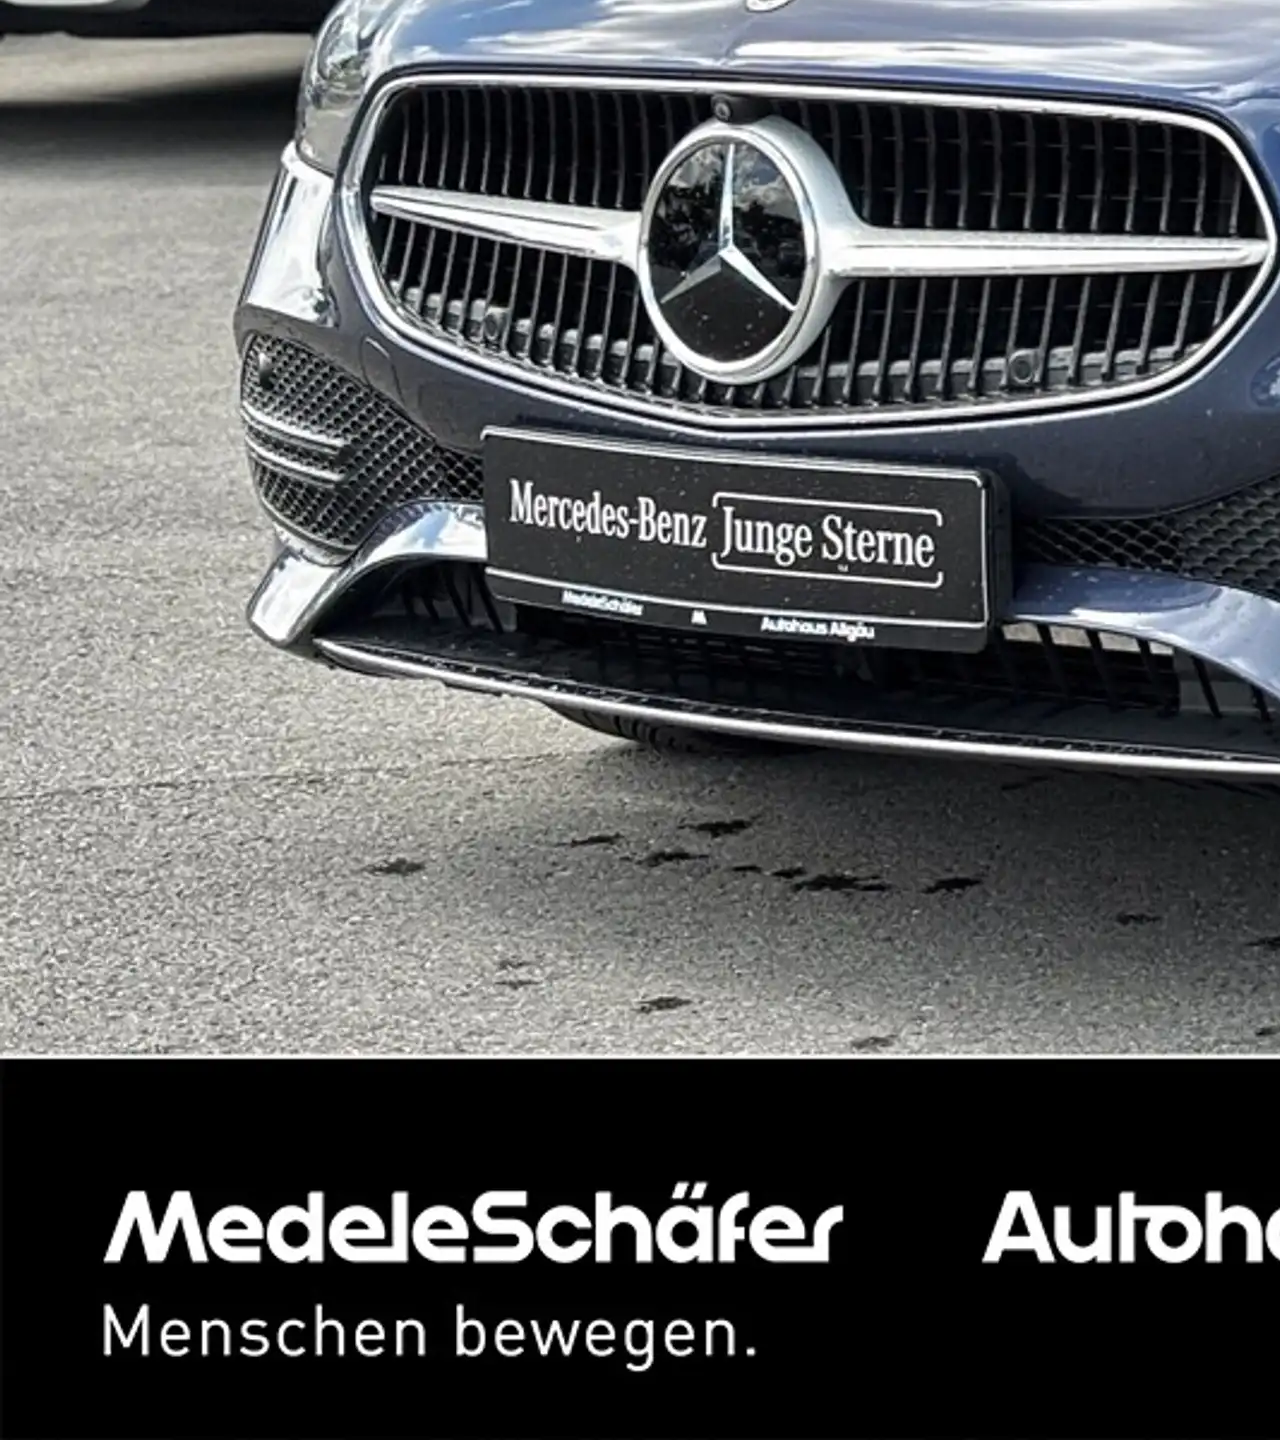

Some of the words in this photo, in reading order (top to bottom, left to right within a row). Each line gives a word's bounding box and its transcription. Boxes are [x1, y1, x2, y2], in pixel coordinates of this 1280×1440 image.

[508, 478, 708, 549] Mercedes-Benz
[720, 505, 814, 566] Junge
[821, 514, 936, 568] Sterne
[761, 616, 827, 636] Autohaus
